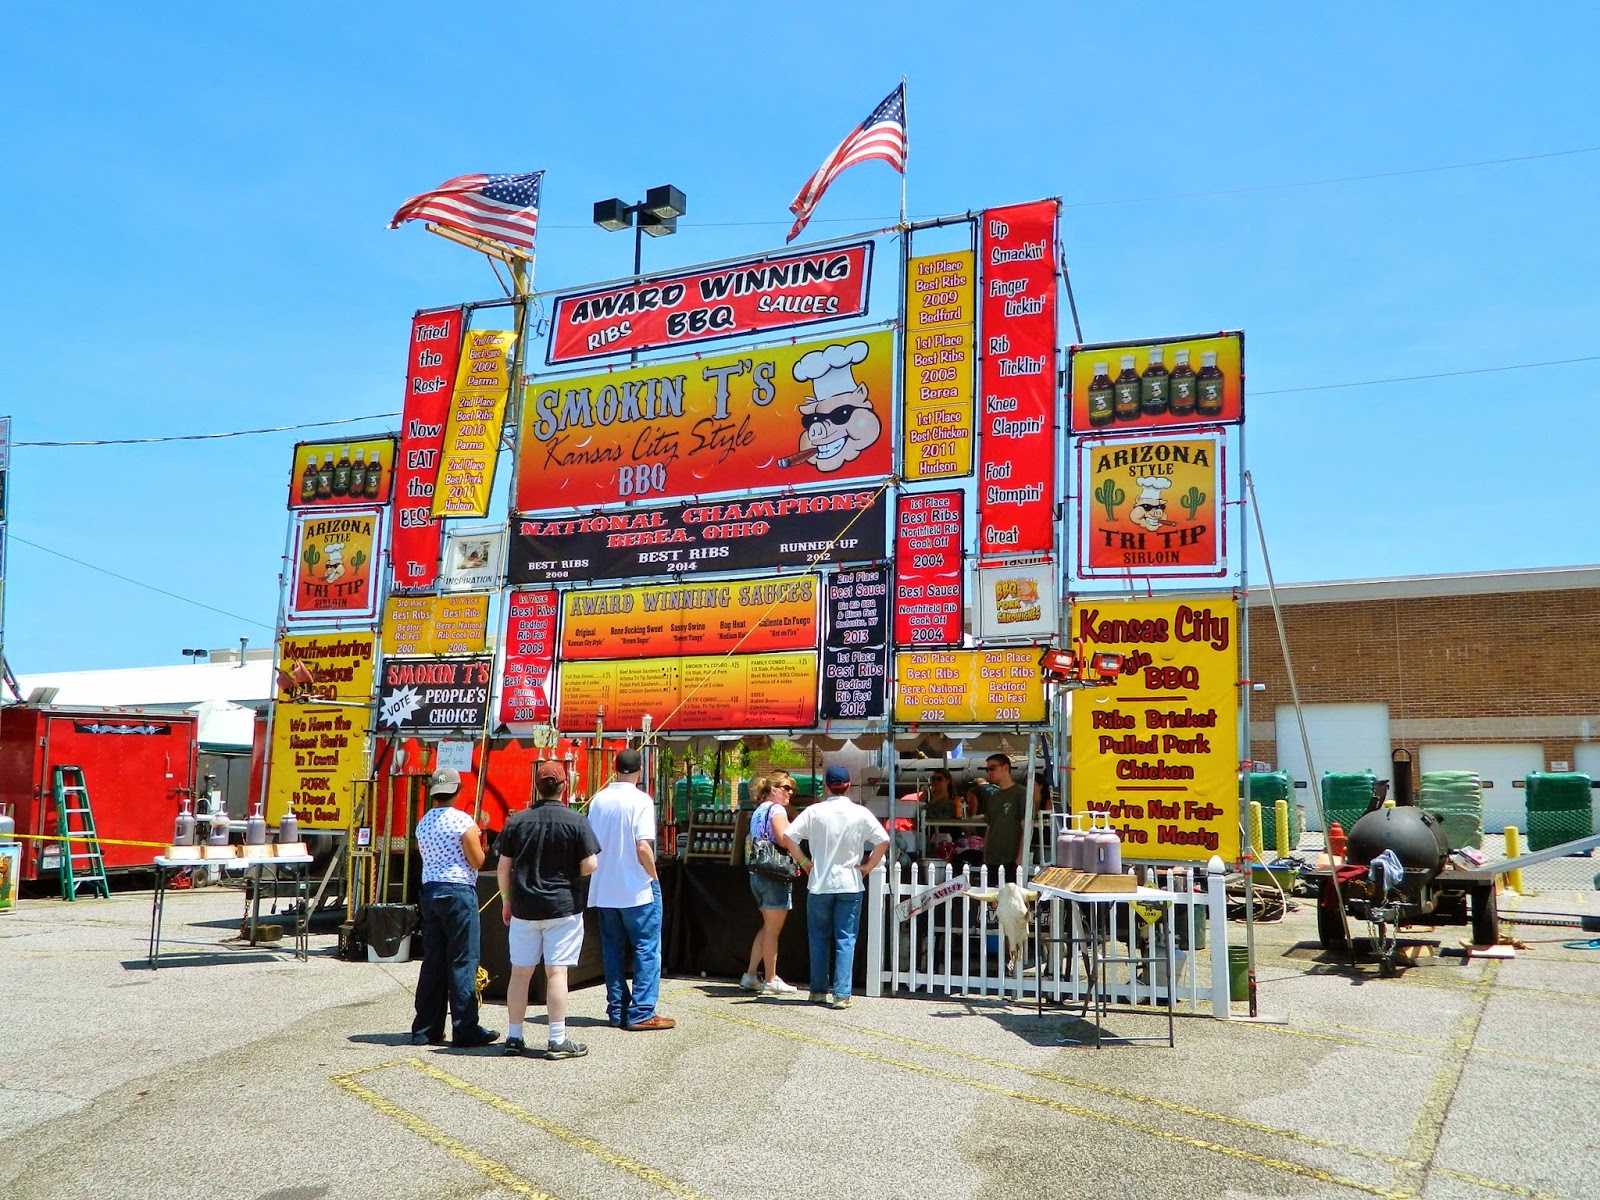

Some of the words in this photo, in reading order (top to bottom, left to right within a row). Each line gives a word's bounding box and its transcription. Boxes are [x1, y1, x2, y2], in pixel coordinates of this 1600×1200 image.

[989, 220, 1008, 238] Lip
[991, 240, 1046, 266] Smackin'
[918, 262, 933, 275] 1st
[936, 260, 963, 272] Place
[570, 283, 685, 324] AWARD
[700, 255, 850, 301] WINNING
[915, 279, 939, 292] Best
[942, 275, 966, 288] Ribs
[989, 278, 1028, 298] Finger
[757, 296, 839, 314] SAUCES
[923, 291, 958, 308] 2009
[1004, 296, 1045, 317] Lickin'
[666, 306, 734, 338] BBQ
[920, 307, 961, 325] Bedford
[416, 321, 449, 342] Tried
[587, 321, 632, 350] RIBS
[916, 337, 932, 350] 1st
[934, 334, 963, 348] Place
[989, 334, 1010, 355] Rib
[420, 350, 442, 367] the
[914, 354, 937, 367] Best
[940, 350, 964, 362] Ribs
[998, 356, 1045, 377] Ticklin'
[467, 376, 498, 386] Parma
[921, 368, 957, 384] 2008
[413, 376, 446, 394] Rest-
[533, 374, 686, 441] SMOKIN
[702, 359, 775, 421] T'S
[920, 387, 958, 400] Berea
[987, 395, 1018, 414] Knee
[409, 421, 441, 438] Now
[458, 424, 486, 436] 2010
[910, 430, 931, 443] Best
[932, 425, 968, 440] Chicken
[992, 416, 1045, 438] Slappin'
[456, 440, 484, 450] Parma
[544, 434, 622, 470] Kansas
[631, 426, 679, 468] City
[688, 414, 756, 463] Style
[922, 443, 956, 458] 2011
[408, 450, 437, 469] EAT
[919, 460, 957, 474] Hudson
[1096, 444, 1210, 475] ARIZONA
[985, 460, 1011, 481] Foot
[1128, 463, 1174, 477] STYLE
[408, 478, 433, 497] the
[445, 475, 463, 485] Best
[464, 474, 482, 485] Pork
[618, 463, 667, 496] BBQ
[448, 487, 475, 498] 2011
[986, 484, 1043, 507] Stompin'
[444, 501, 473, 511] Hudson
[519, 512, 668, 536] NATIONAL
[681, 492, 875, 524] CHAMPIONS
[902, 512, 926, 524] Best
[932, 510, 958, 521] Ribs
[306, 520, 372, 540] ARIZONA
[324, 533, 351, 543] STYLE
[702, 521, 770, 539] OHIO
[902, 526, 941, 538] Northfield
[944, 524, 959, 534] Rib
[986, 525, 1018, 544] Great
[1099, 528, 1146, 550] TRI
[1157, 524, 1207, 548] TIP
[780, 539, 858, 552] RUNNER-UP
[638, 549, 682, 563] BEST
[689, 546, 729, 560] RIBS
[806, 553, 831, 562] 2012
[914, 554, 944, 568] 2004
[1123, 551, 1180, 565] SIRLOIN
[528, 560, 557, 570] BEST
[561, 559, 589, 569] RIBS
[666, 562, 697, 572] 2014
[304, 582, 328, 598] TRI
[335, 579, 364, 596] TIP
[446, 576, 492, 585] INSPIRATION
[570, 593, 634, 616] AWARD
[642, 586, 731, 612] WINNING
[738, 581, 812, 606] SAUCES
[830, 586, 853, 599] Best
[856, 583, 885, 597] Sauce
[899, 584, 923, 598] Best
[928, 583, 959, 596] Sauce
[995, 581, 1017, 601] BBQ
[997, 600, 1021, 610] PORK
[759, 617, 782, 627] Caliente
[784, 617, 791, 625] En
[792, 616, 810, 626] Fuego
[868, 617, 878, 626] NY
[997, 606, 1041, 624] SANDWICHES
[575, 628, 596, 637] Original
[610, 627, 623, 635] Bone
[624, 626, 645, 636] Sucking
[646, 625, 663, 633] Sweet
[670, 623, 688, 633] Sassy
[688, 622, 705, 630] Swine
[720, 621, 732, 630] Hog
[733, 620, 746, 628] Heat
[1080, 608, 1169, 644] Kansas
[1174, 605, 1229, 650] City
[843, 630, 869, 644] 2013
[912, 629, 943, 641] 2004
[284, 640, 372, 660] Mouthwatering
[519, 644, 544, 654] 2009
[387, 664, 456, 686] SMOKIN
[461, 662, 490, 684] T'S
[1145, 666, 1200, 690] BBQ
[836, 679, 871, 690] Bedford
[901, 685, 925, 694] Berea
[929, 684, 966, 693] National
[989, 681, 1026, 691] Bedford
[425, 688, 486, 704] PEOPLE'S
[836, 692, 851, 702] Rib
[852, 690, 872, 701] Fest
[387, 694, 411, 717] VOTE
[840, 703, 866, 716] 2014
[996, 708, 1020, 719] 2013
[429, 709, 477, 724] CHOICE
[514, 708, 534, 720] 2010
[921, 710, 945, 720] 2012
[1092, 710, 1136, 730] Ribs
[1145, 708, 1217, 729] Brisket
[290, 718, 306, 732] We
[308, 717, 332, 731] Have
[334, 715, 352, 730] the
[321, 734, 348, 748] Butts
[1098, 734, 1158, 755] Pulled
[1162, 733, 1211, 754] Pork
[295, 752, 305, 766] In
[307, 750, 338, 766] Town!
[1116, 759, 1194, 780] Chicken
[300, 777, 330, 790] PORK
[292, 792, 300, 805] It
[302, 792, 326, 805] Does
[326, 792, 336, 805] A
[314, 807, 340, 822] Good
[1087, 800, 1144, 820] We're
[1148, 800, 1181, 820] Not
[1184, 801, 1224, 821] Fat-
[1157, 824, 1219, 850] Meaty
